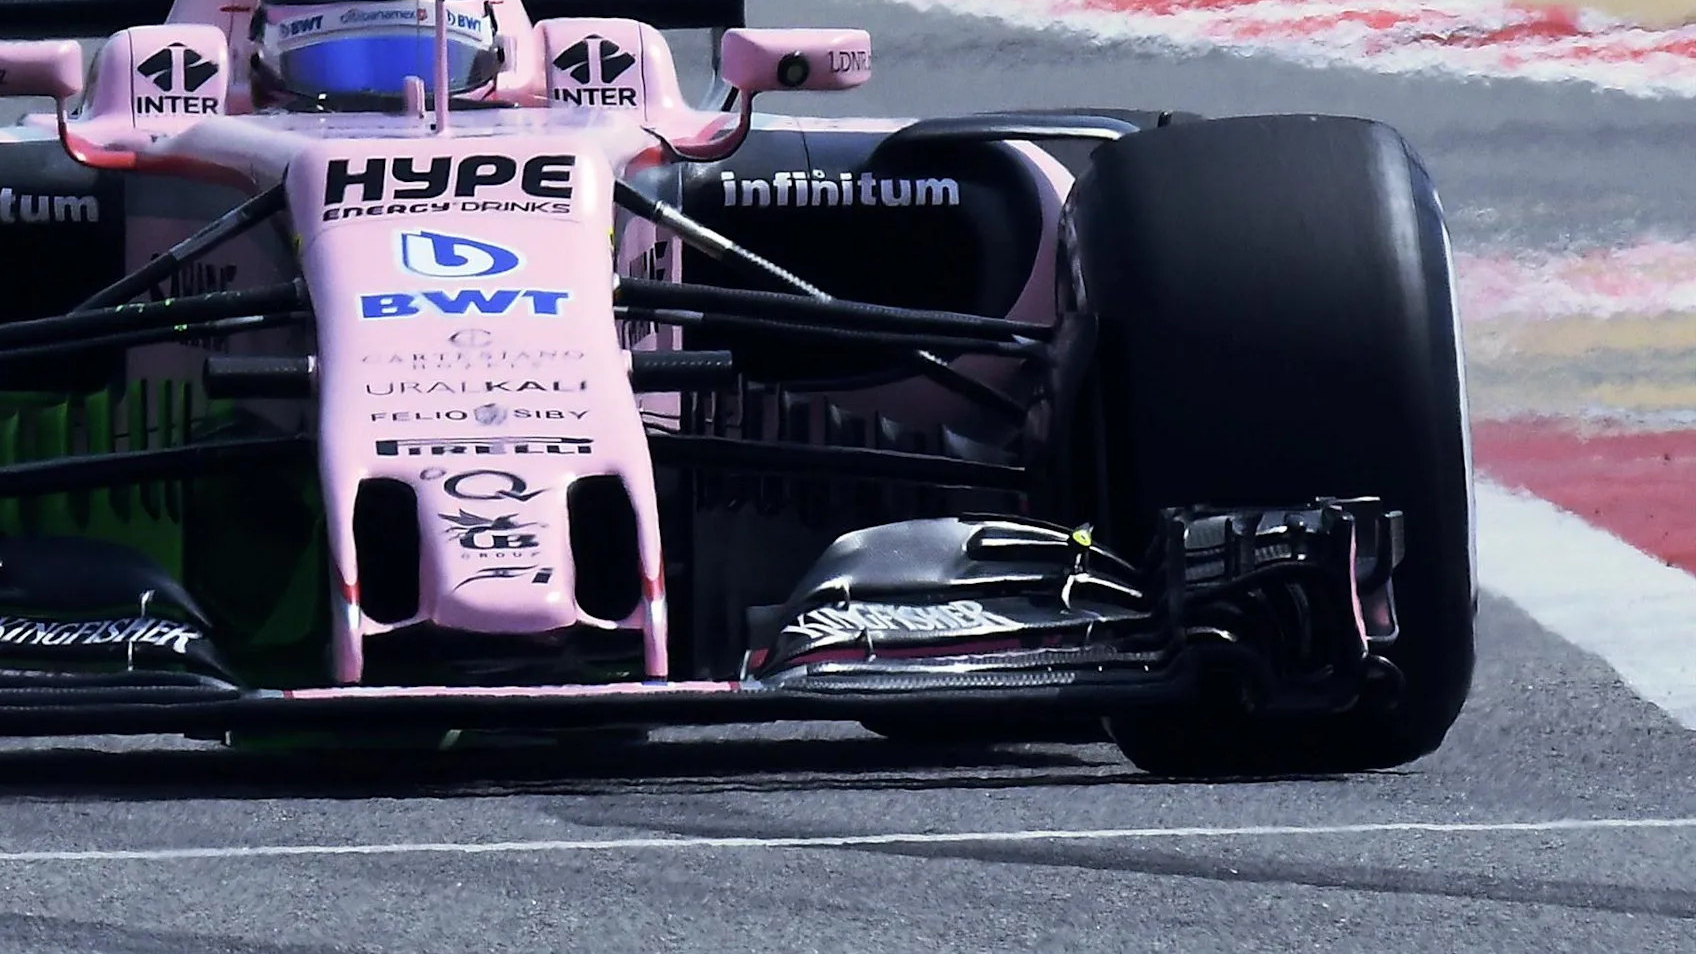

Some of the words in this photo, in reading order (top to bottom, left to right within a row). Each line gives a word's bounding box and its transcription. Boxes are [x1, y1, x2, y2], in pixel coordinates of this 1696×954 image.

[135, 95, 218, 115] INTER
[554, 86, 637, 107] INTER
[324, 155, 576, 205] HYPE
[722, 170, 961, 207] infinitum
[322, 202, 450, 222] ENERGY
[460, 200, 571, 214] DRINKS
[360, 289, 569, 319] BWT
[366, 380, 588, 396] URALKALI
[370, 409, 468, 422] FELIO
[513, 408, 590, 421] SIBY
[375, 436, 595, 456] PIRELLI
